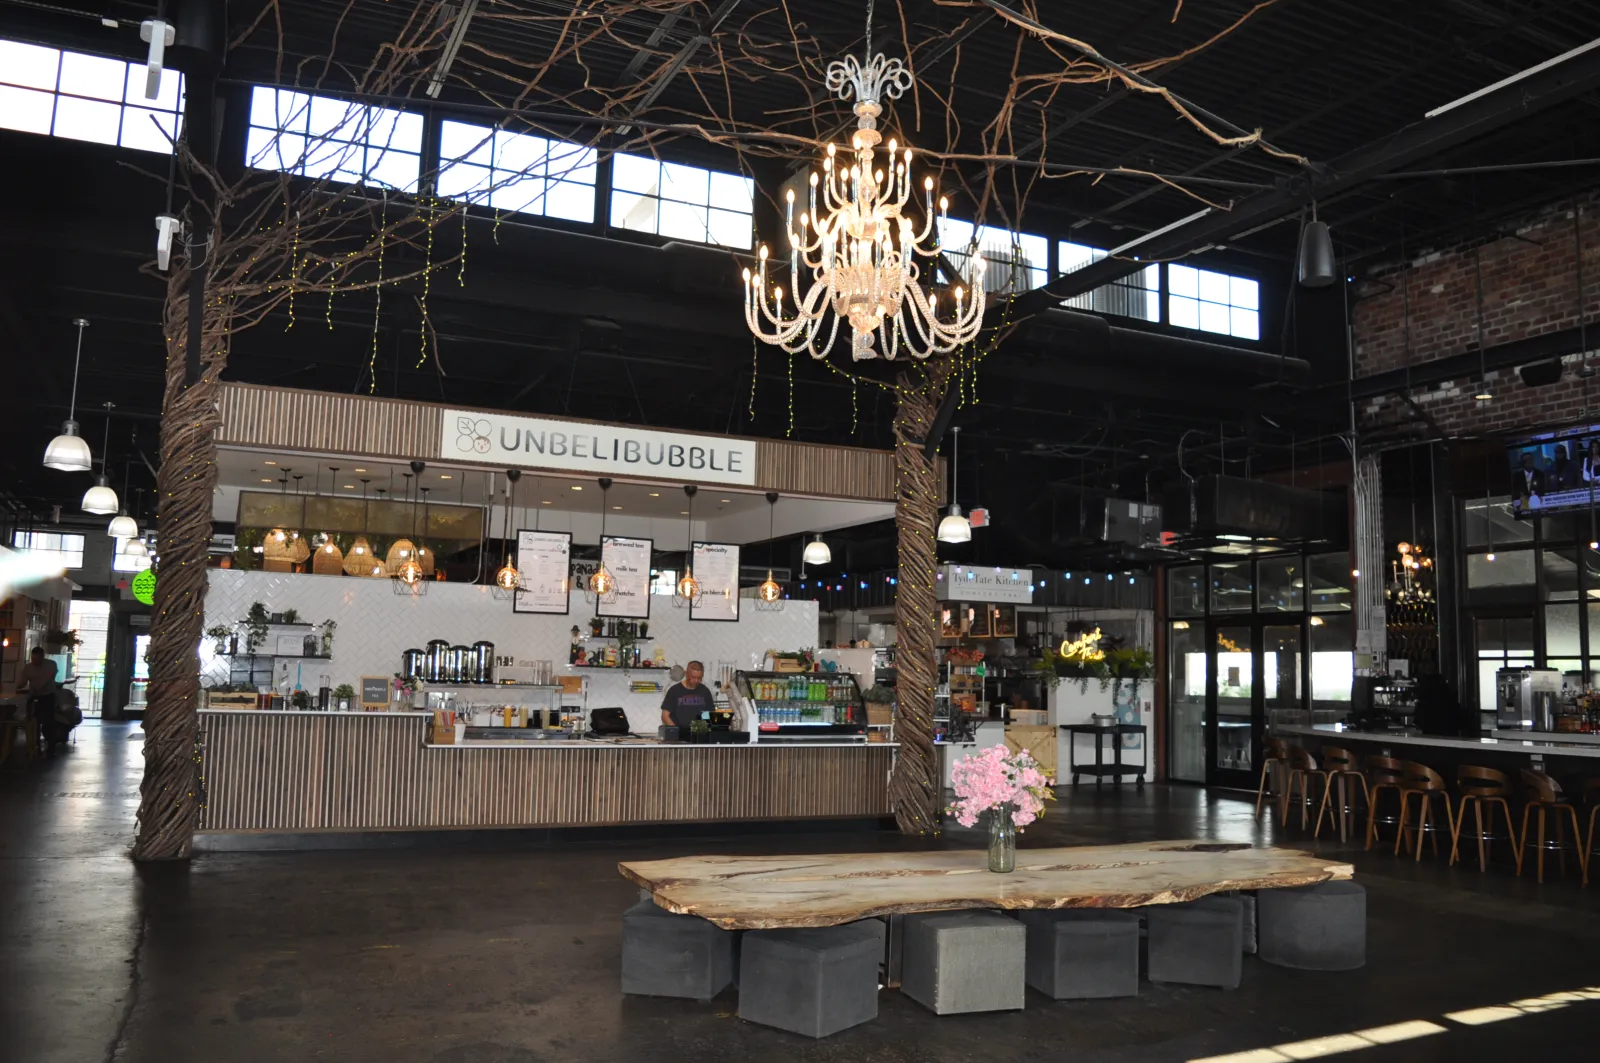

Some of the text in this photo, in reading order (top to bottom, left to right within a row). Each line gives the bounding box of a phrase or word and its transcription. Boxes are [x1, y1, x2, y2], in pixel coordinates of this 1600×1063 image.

[499, 426, 744, 473] UNBELIBUBBLE
[705, 547, 728, 555] specialty
[576, 575, 584, 590] &
[995, 574, 1029, 587] Kitchen
